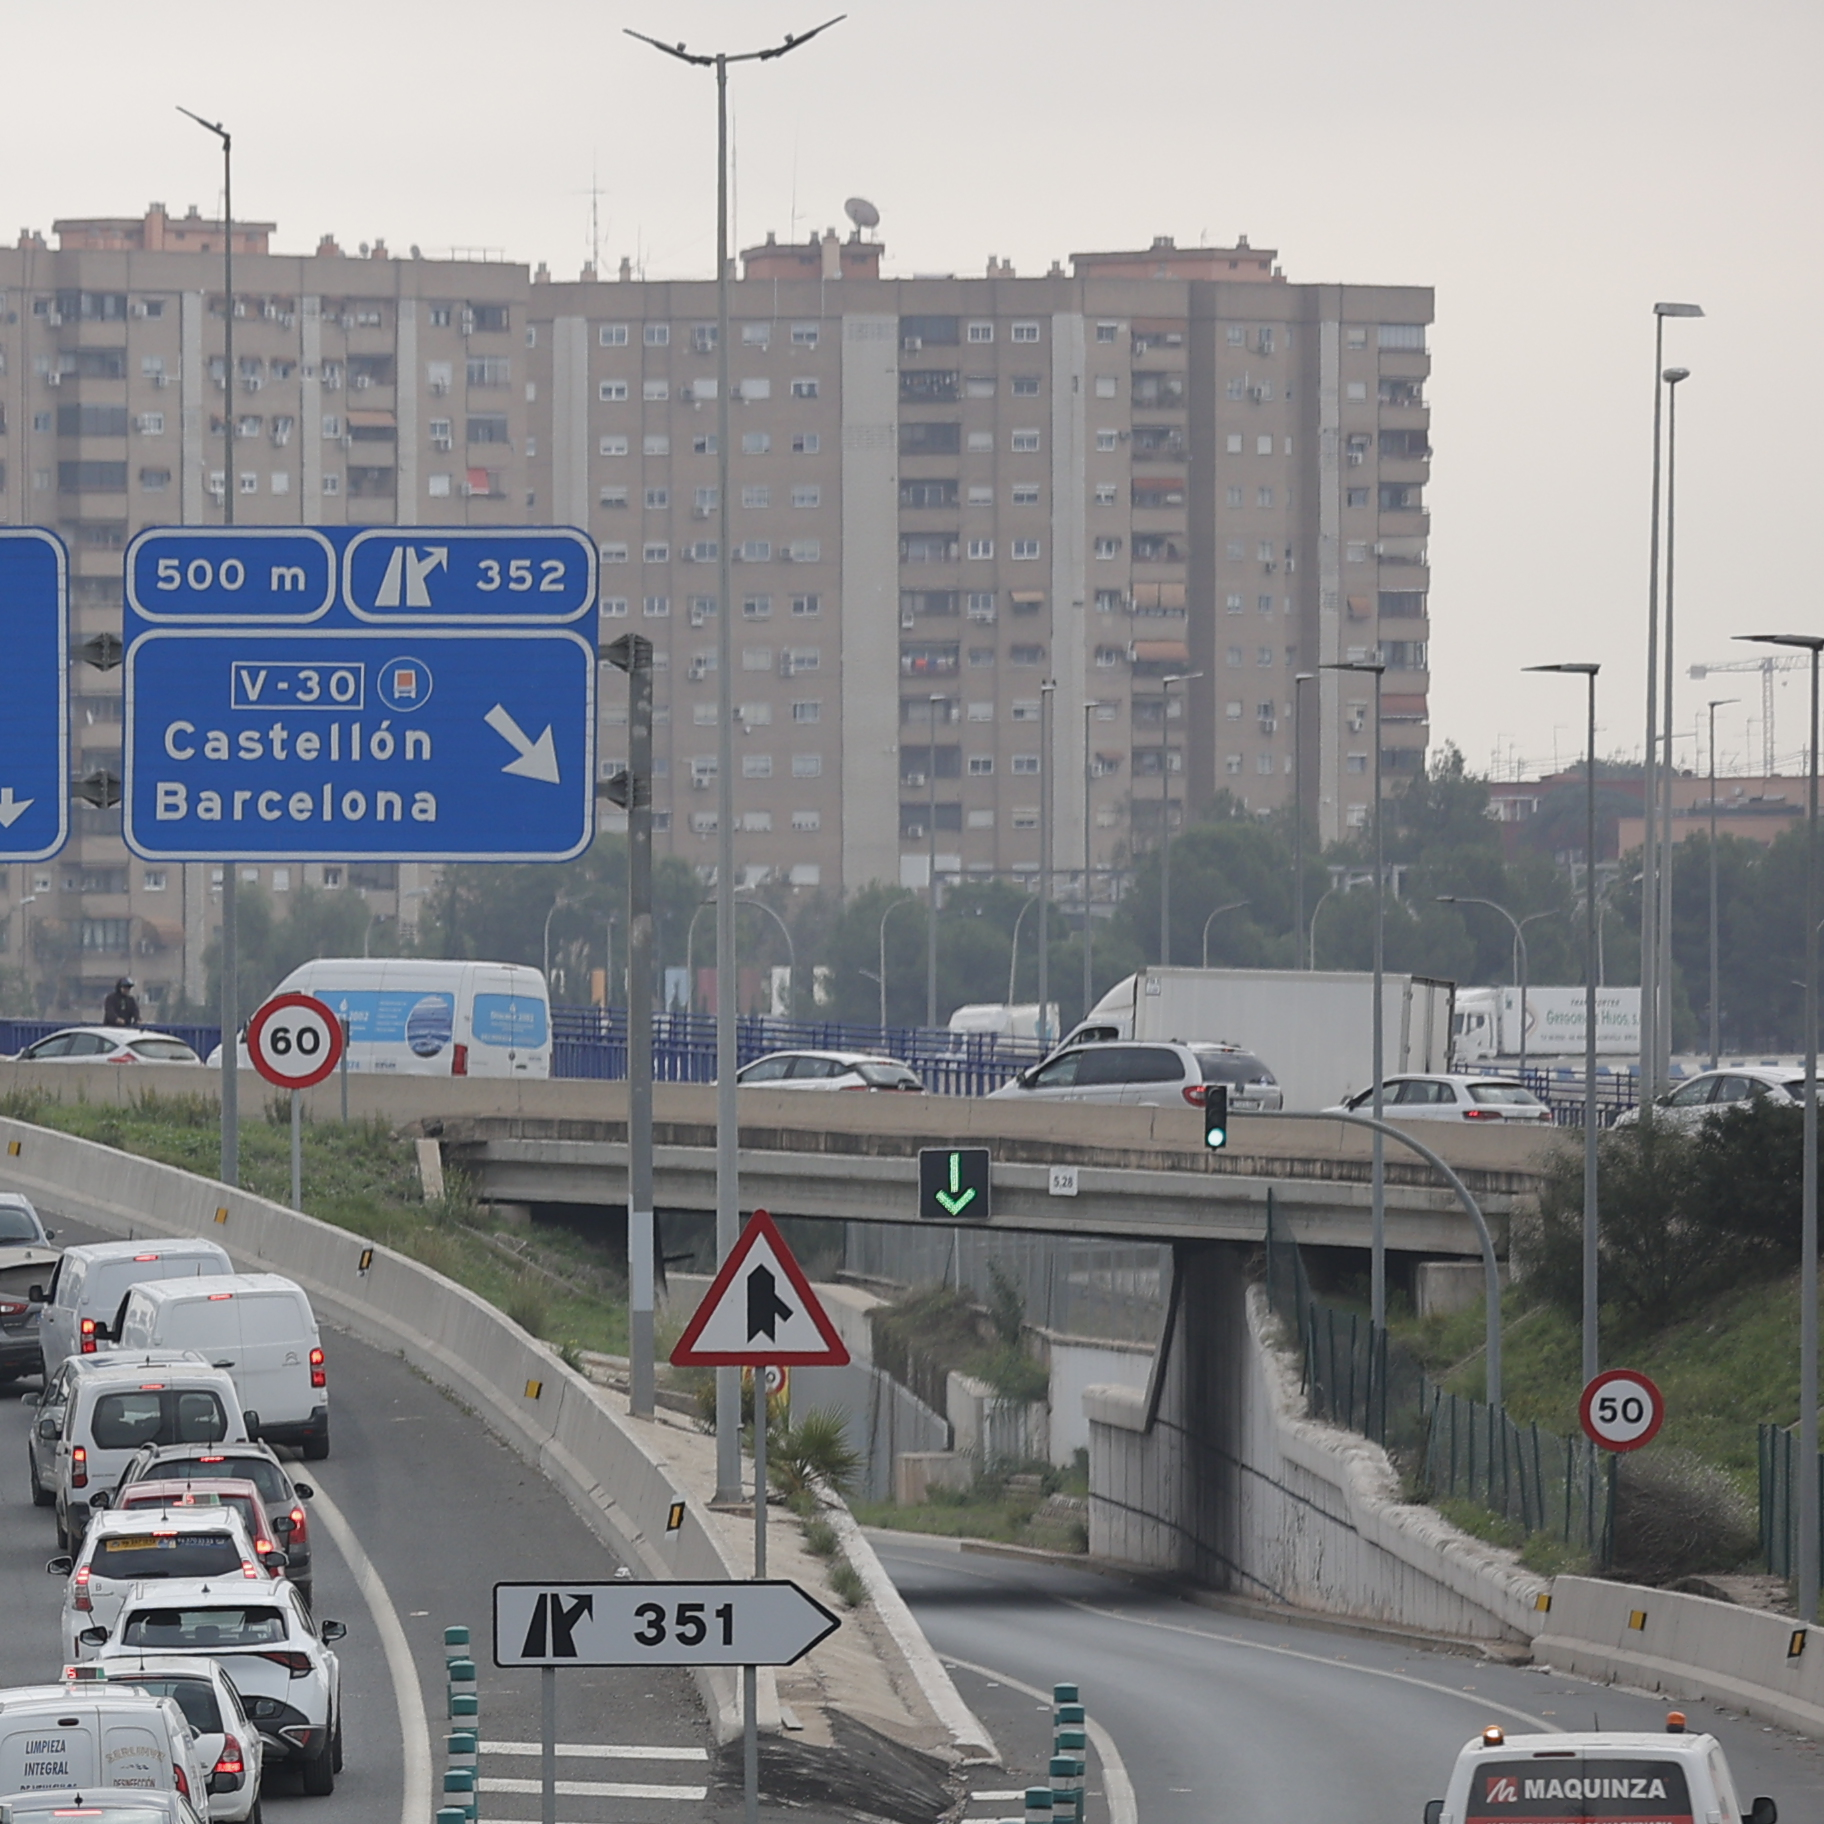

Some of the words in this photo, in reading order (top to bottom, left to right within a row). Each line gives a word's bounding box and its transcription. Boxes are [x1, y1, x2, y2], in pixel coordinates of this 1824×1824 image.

[156, 560, 245, 592] 500
[270, 566, 307, 593] m
[476, 559, 567, 592] 352
[241, 667, 357, 703] V-30
[163, 718, 433, 762] Castellón
[156, 780, 439, 823] Barcelona
[270, 1027, 320, 1055] 60
[1598, 1397, 1644, 1424] 50
[633, 1602, 735, 1647] 351
[26, 1740, 67, 1755] LIMPIEZA
[25, 1762, 69, 1777] INTEGRAL
[1524, 1777, 1667, 1802] MAQUINZA
